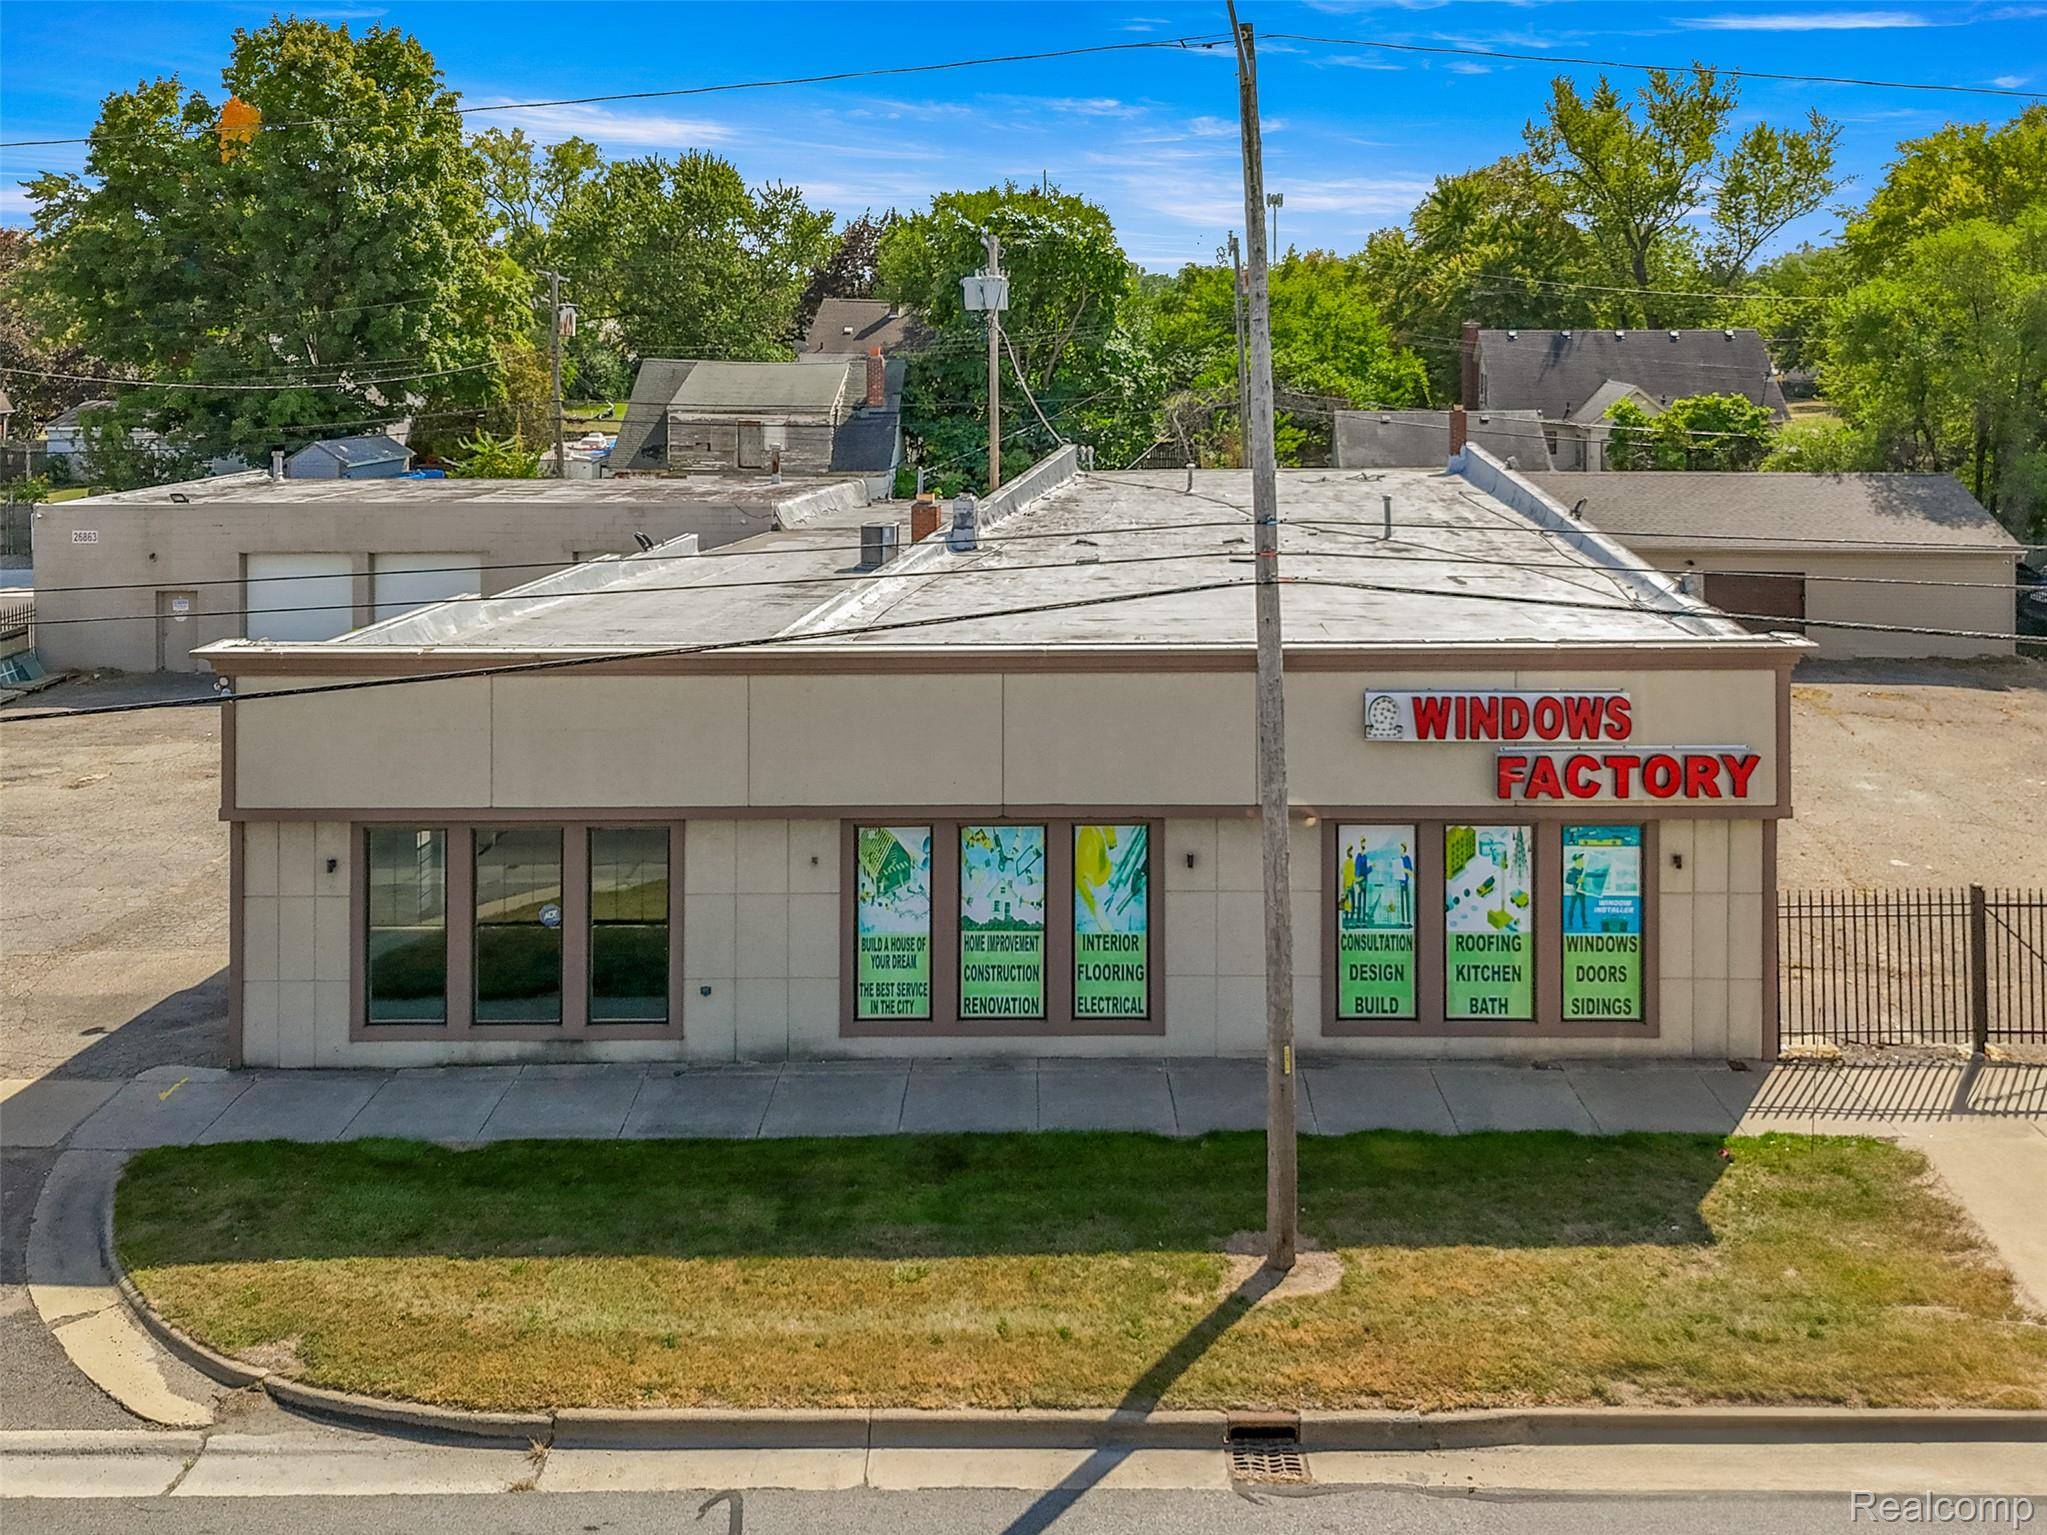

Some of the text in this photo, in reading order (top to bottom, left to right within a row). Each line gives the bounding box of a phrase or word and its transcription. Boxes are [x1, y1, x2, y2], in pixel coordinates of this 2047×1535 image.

[1412, 696, 1632, 741] WINDOWS
[1497, 754, 1760, 799] FACTORY
[861, 937, 926, 952] BUILD A HOUSE OF
[964, 935, 1039, 952] HOME IMPROVEMENT
[1082, 934, 1139, 952] INTERIOR
[1341, 934, 1413, 952] CONSULTATION
[1455, 934, 1522, 952] ROOFING
[1565, 935, 1638, 953] WINDOWS
[871, 954, 917, 969] YOUR DREAM
[964, 964, 1039, 982] CONSTRUCTION
[1077, 964, 1144, 981] FLOORING
[1349, 964, 1404, 982] DESIGN
[1455, 964, 1522, 982] KITCHEN
[1575, 965, 1628, 982] DOORS
[860, 982, 928, 997] THE BEST SERVICE
[871, 1000, 914, 1014] IN THE CITY
[964, 997, 1039, 1014] RENOVATION
[1077, 996, 1144, 1014] ELECTRICAL
[1355, 997, 1399, 1015] BUILD
[1469, 997, 1508, 1015] BATH
[1571, 997, 1632, 1015] SIDINGS
